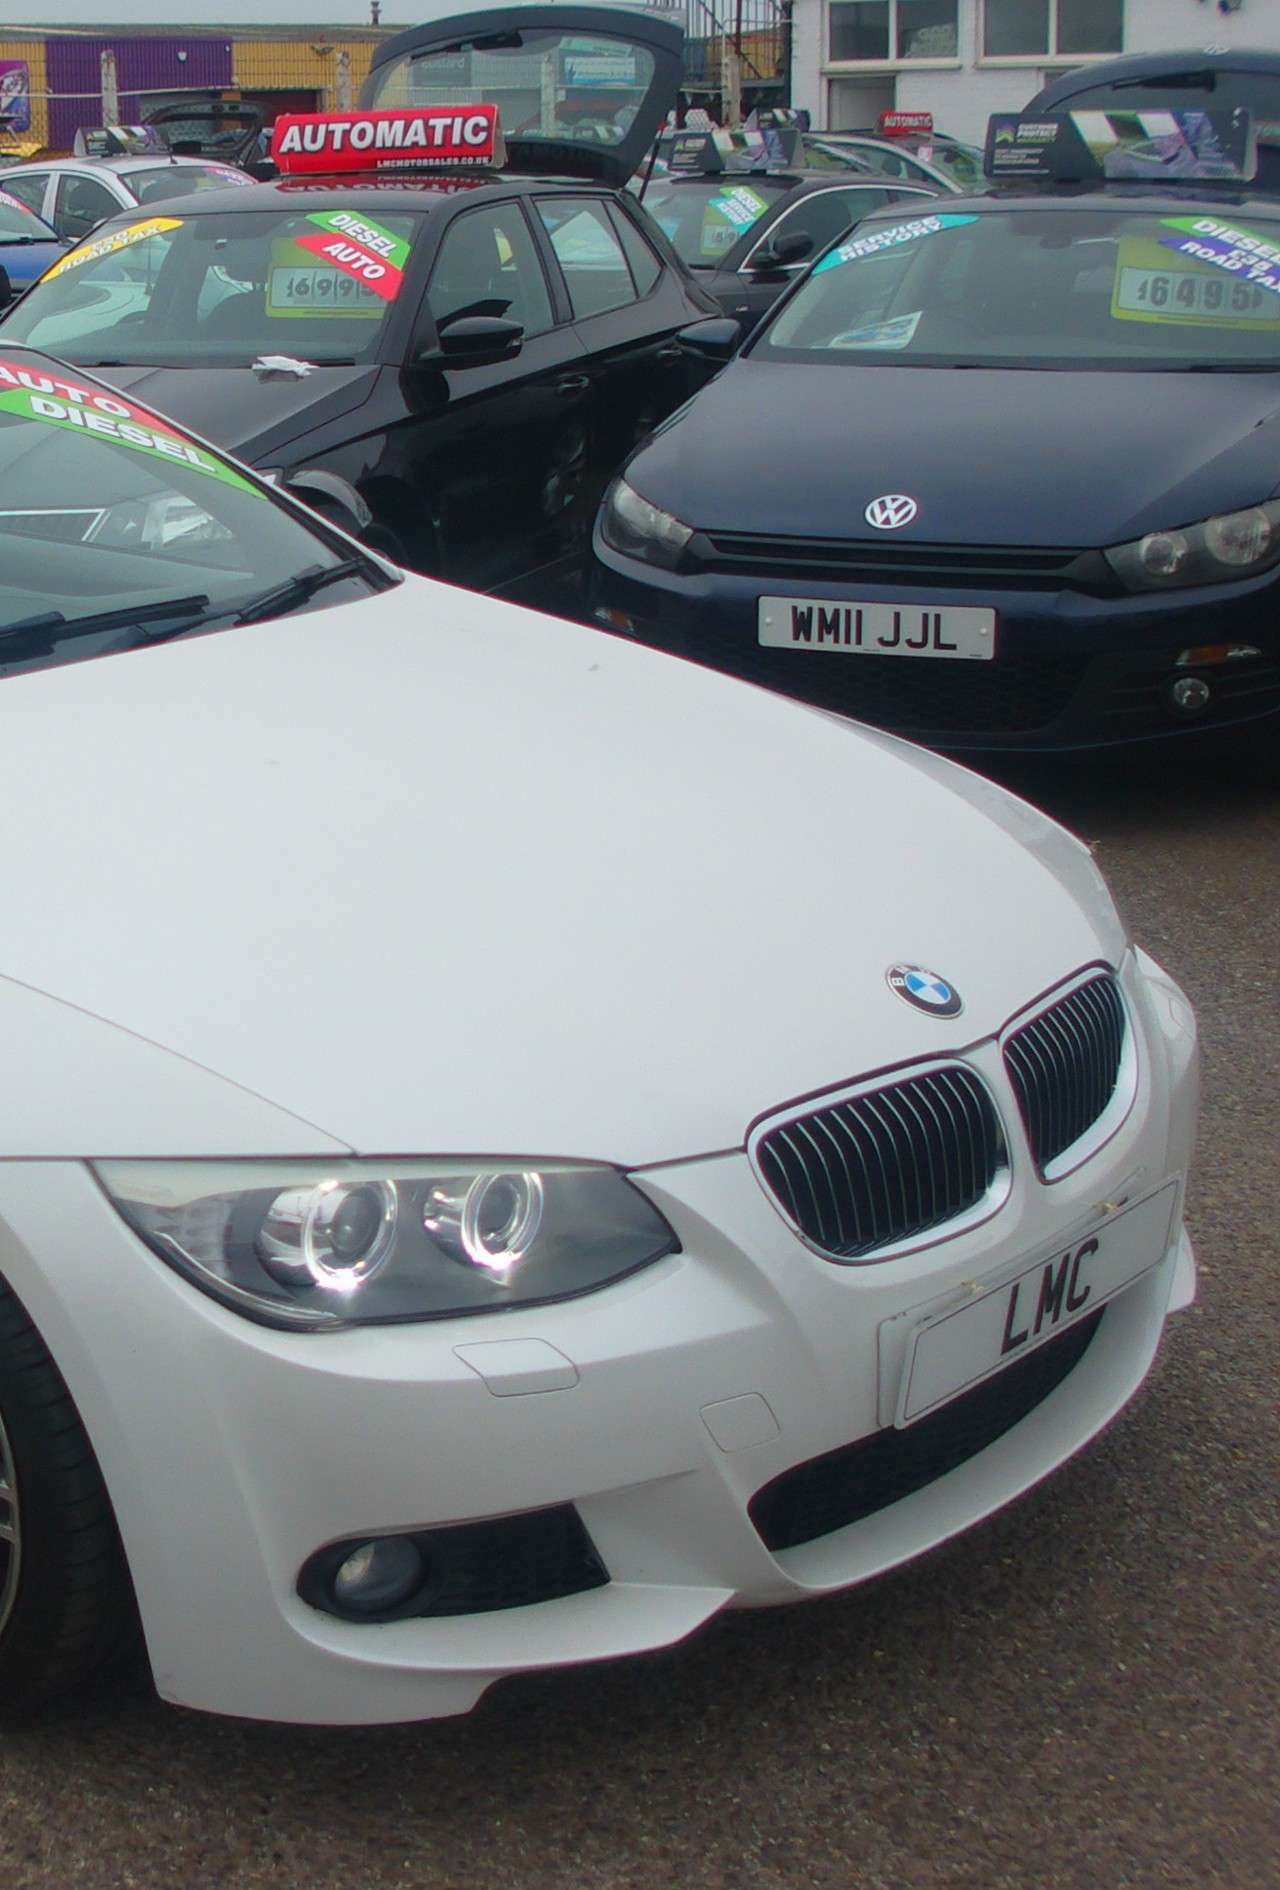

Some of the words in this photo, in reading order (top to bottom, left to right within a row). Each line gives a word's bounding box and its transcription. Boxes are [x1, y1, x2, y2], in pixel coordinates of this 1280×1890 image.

[279, 115, 489, 153] AUTOMATIC
[328, 214, 397, 257] DIESEL
[837, 215, 938, 252] SERVICE
[322, 242, 386, 279] AUTO
[1180, 241, 1242, 270] ROAD
[30, 396, 216, 472] DIESEL
[877, 611, 957, 651] JJL
[1000, 1236, 1099, 1357] LMC
